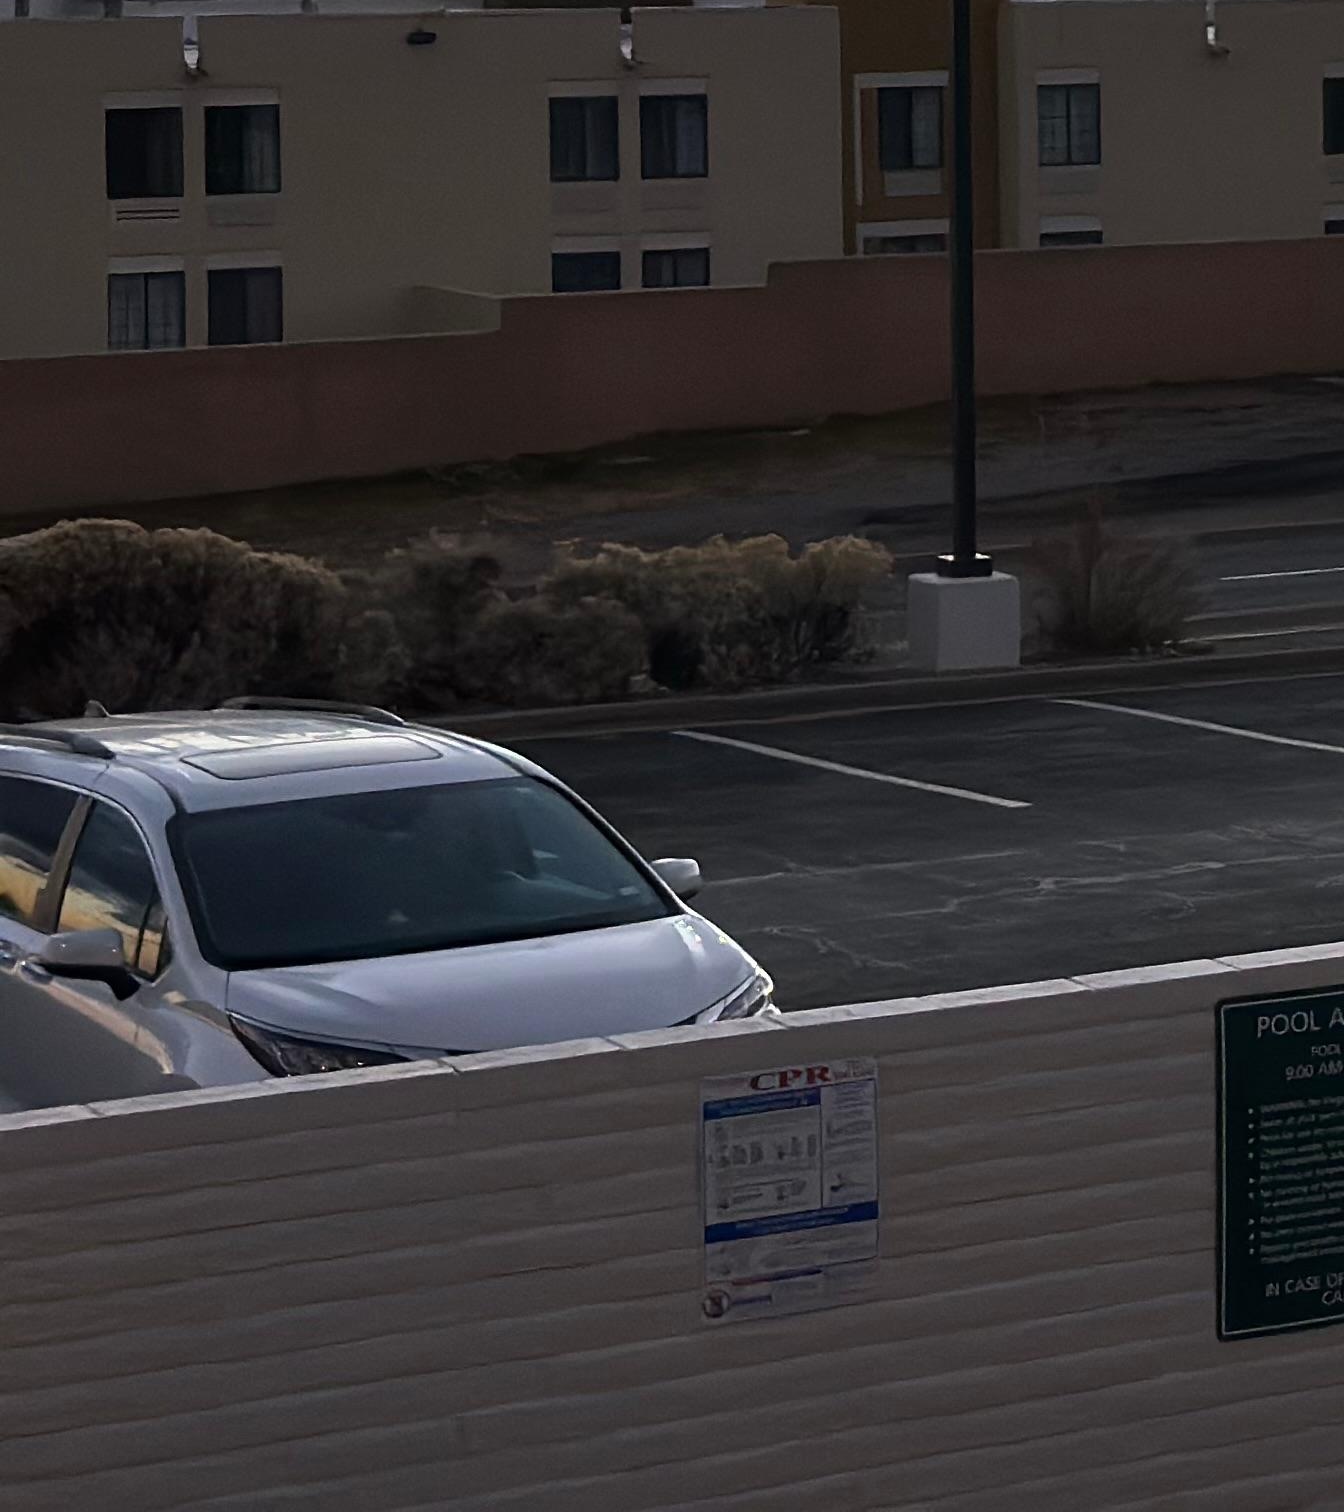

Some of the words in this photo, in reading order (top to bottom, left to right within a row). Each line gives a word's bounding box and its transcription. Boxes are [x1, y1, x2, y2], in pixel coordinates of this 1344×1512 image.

[1256, 1010, 1322, 1038] POOL
[1311, 1043, 1342, 1056] POOL
[750, 1066, 831, 1091] CPR
[1317, 1059, 1344, 1076] AM
[1265, 1281, 1280, 1297] IN
[1284, 1275, 1321, 1295] CASE
[1326, 1271, 1344, 1288] OF
